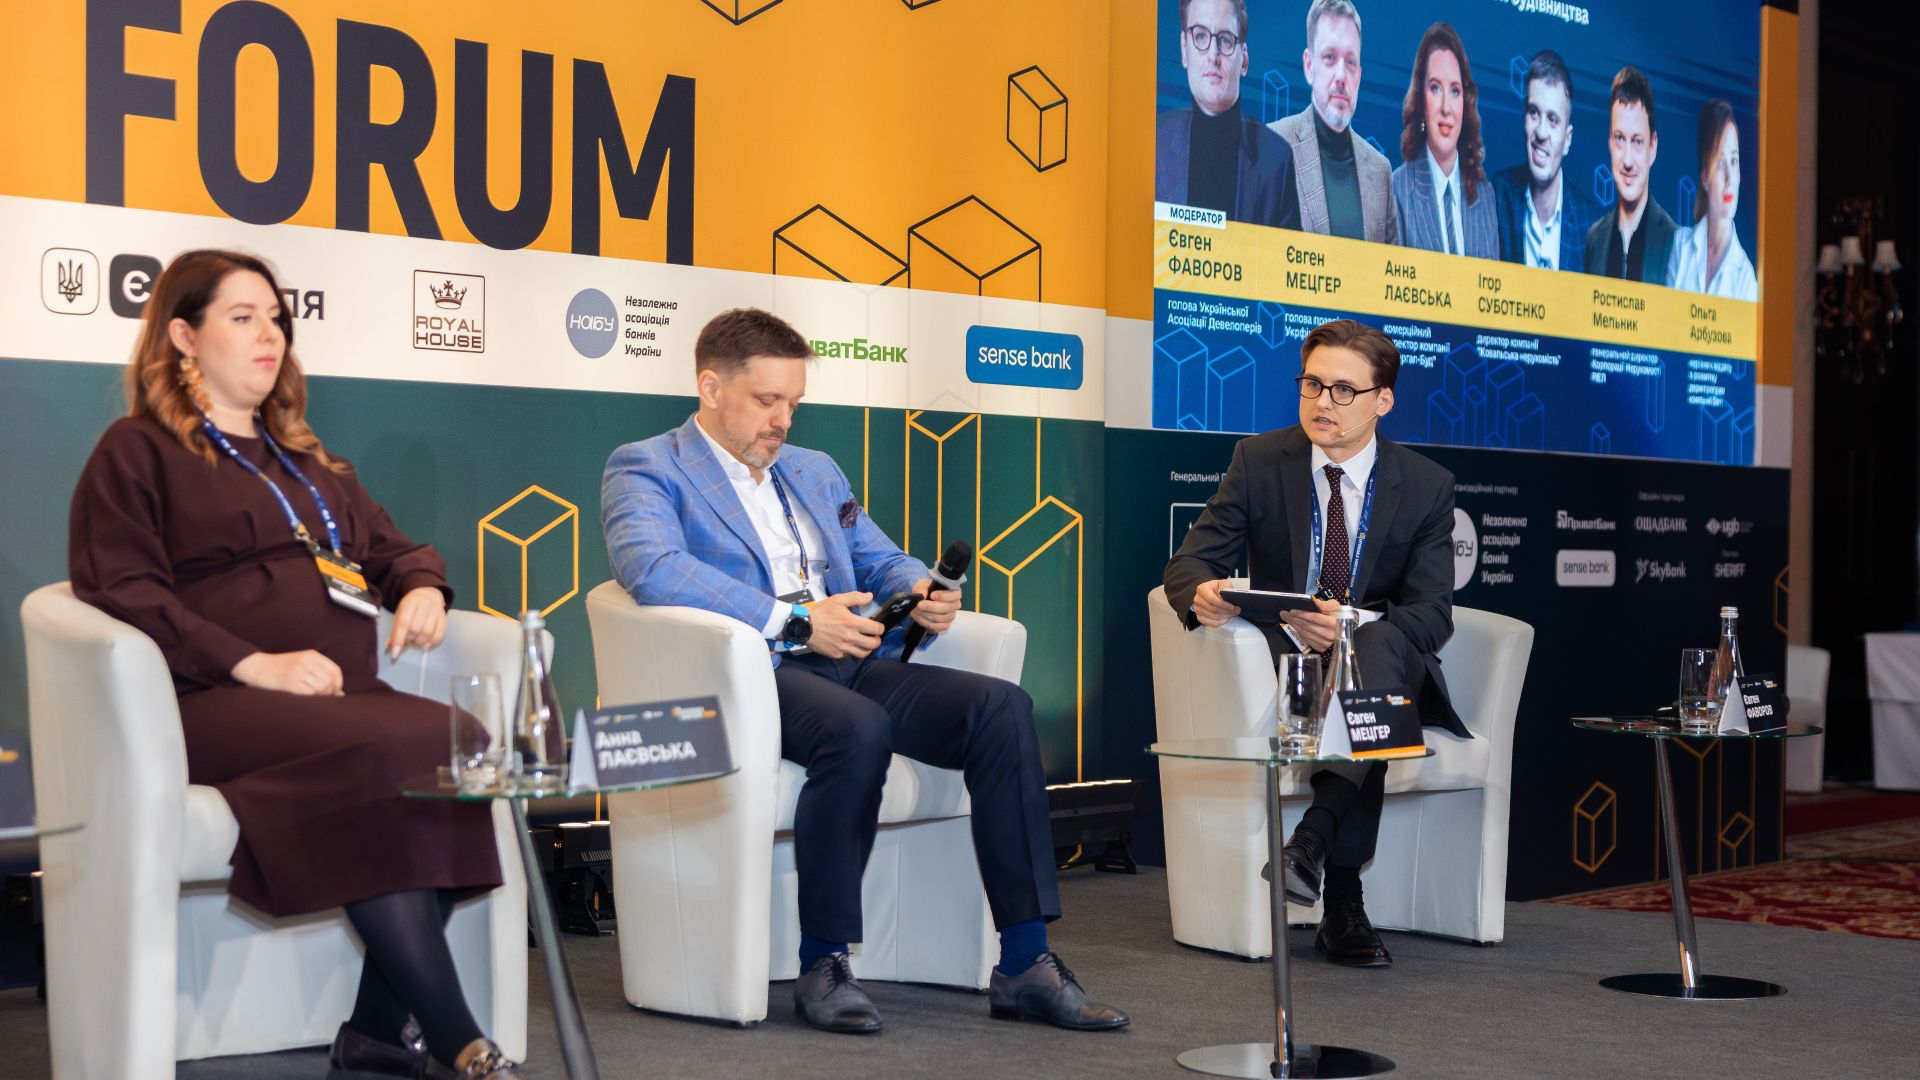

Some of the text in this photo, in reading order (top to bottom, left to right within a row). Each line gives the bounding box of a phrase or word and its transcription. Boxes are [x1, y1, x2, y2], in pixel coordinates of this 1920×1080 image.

[85, 0, 696, 266] FORUM
[1170, 207, 1223, 225] МОДЕРАТОР
[1169, 229, 1212, 251] Євген
[1286, 245, 1325, 267] Євген
[1169, 256, 1242, 282] ФАВОРОВ
[1385, 260, 1416, 279] Анна
[1286, 271, 1341, 294] МЕЦГЕР
[1478, 273, 1501, 292] Ігор
[625, 295, 678, 310] Незалежна
[1385, 285, 1452, 308] ЛАЄВСЬКА
[1593, 289, 1645, 312] Ростислав
[1168, 300, 1249, 318] голова Української
[1478, 297, 1546, 320] СУБОТЕНКО
[1690, 304, 1717, 321] Ольга
[416, 315, 482, 333] ROYAL
[625, 315, 670, 326] асоціація
[1168, 313, 1262, 334] Асоціації Девелоперів
[1285, 313, 1312, 325] голова
[1593, 313, 1638, 332] Мельник
[416, 332, 482, 349] HOUSE
[625, 328, 656, 341] банків
[1690, 326, 1732, 345] Арбузова
[625, 344, 662, 358] України
[809, 338, 908, 363] ватБанк
[978, 345, 1072, 370] sense bank
[1170, 471, 1220, 484] Генеральний
[1482, 513, 1528, 527] Незалежна
[1568, 516, 1617, 532] ПриватБанк
[1635, 516, 1688, 533] ОЩАДБАНК
[1482, 532, 1521, 546] асоціація
[1482, 551, 1509, 564] банків
[1563, 560, 1609, 574] sense bank
[1650, 561, 1687, 581] SkyBank
[1482, 570, 1514, 585] України
[1346, 711, 1376, 725] Євген
[1746, 704, 1774, 719] ФАВОРОВ
[595, 730, 643, 750] Анна
[1350, 725, 1391, 742] МЕЦГЕР
[598, 740, 698, 771] ЛАЄВСЬКА
